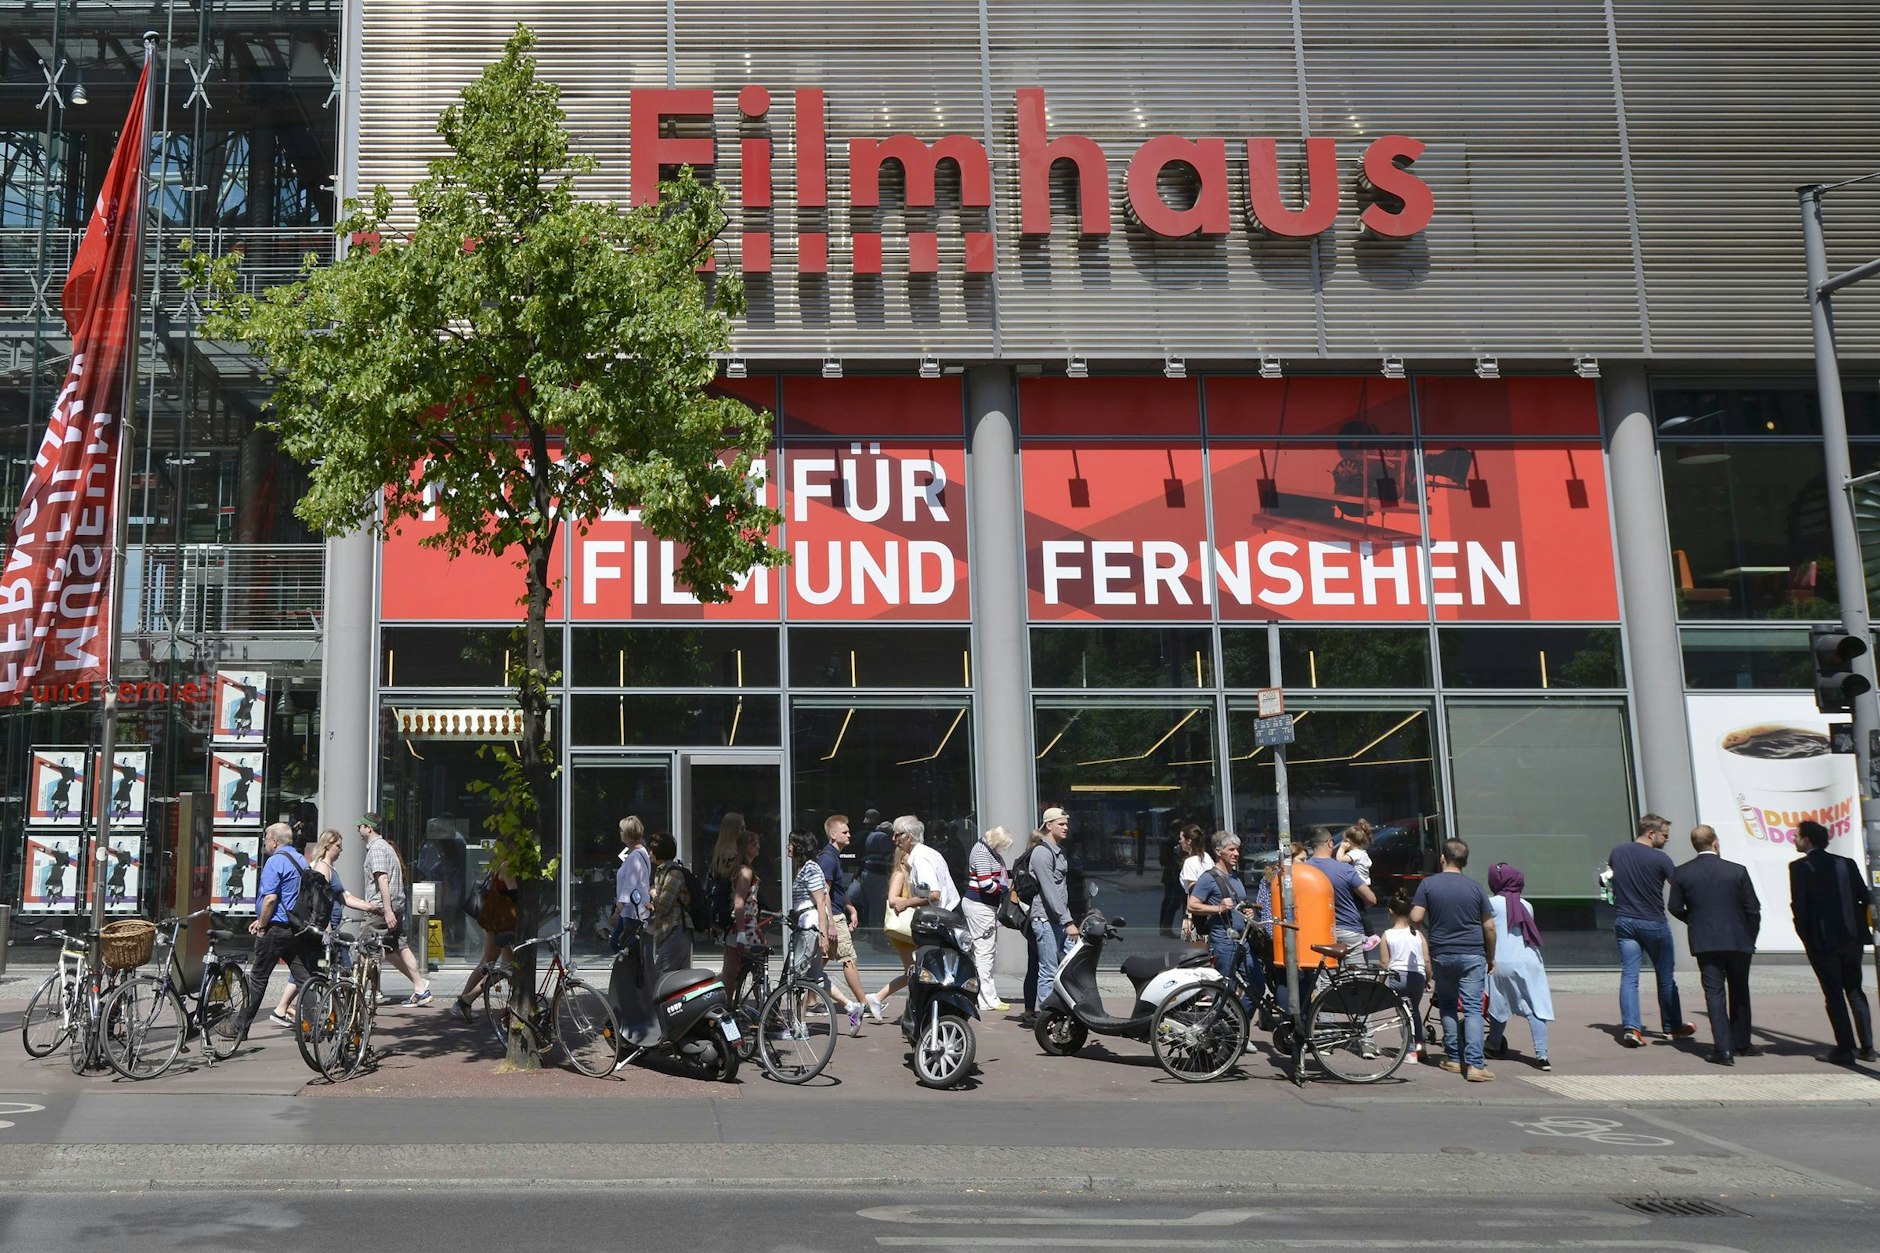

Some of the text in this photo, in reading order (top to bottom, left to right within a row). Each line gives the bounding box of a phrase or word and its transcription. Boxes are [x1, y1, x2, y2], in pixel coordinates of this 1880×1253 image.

[631, 84, 1435, 238] Filmhaus
[794, 442, 950, 523] FÜR
[795, 540, 955, 605] UND
[1042, 540, 1521, 606] FERNSEHEN
